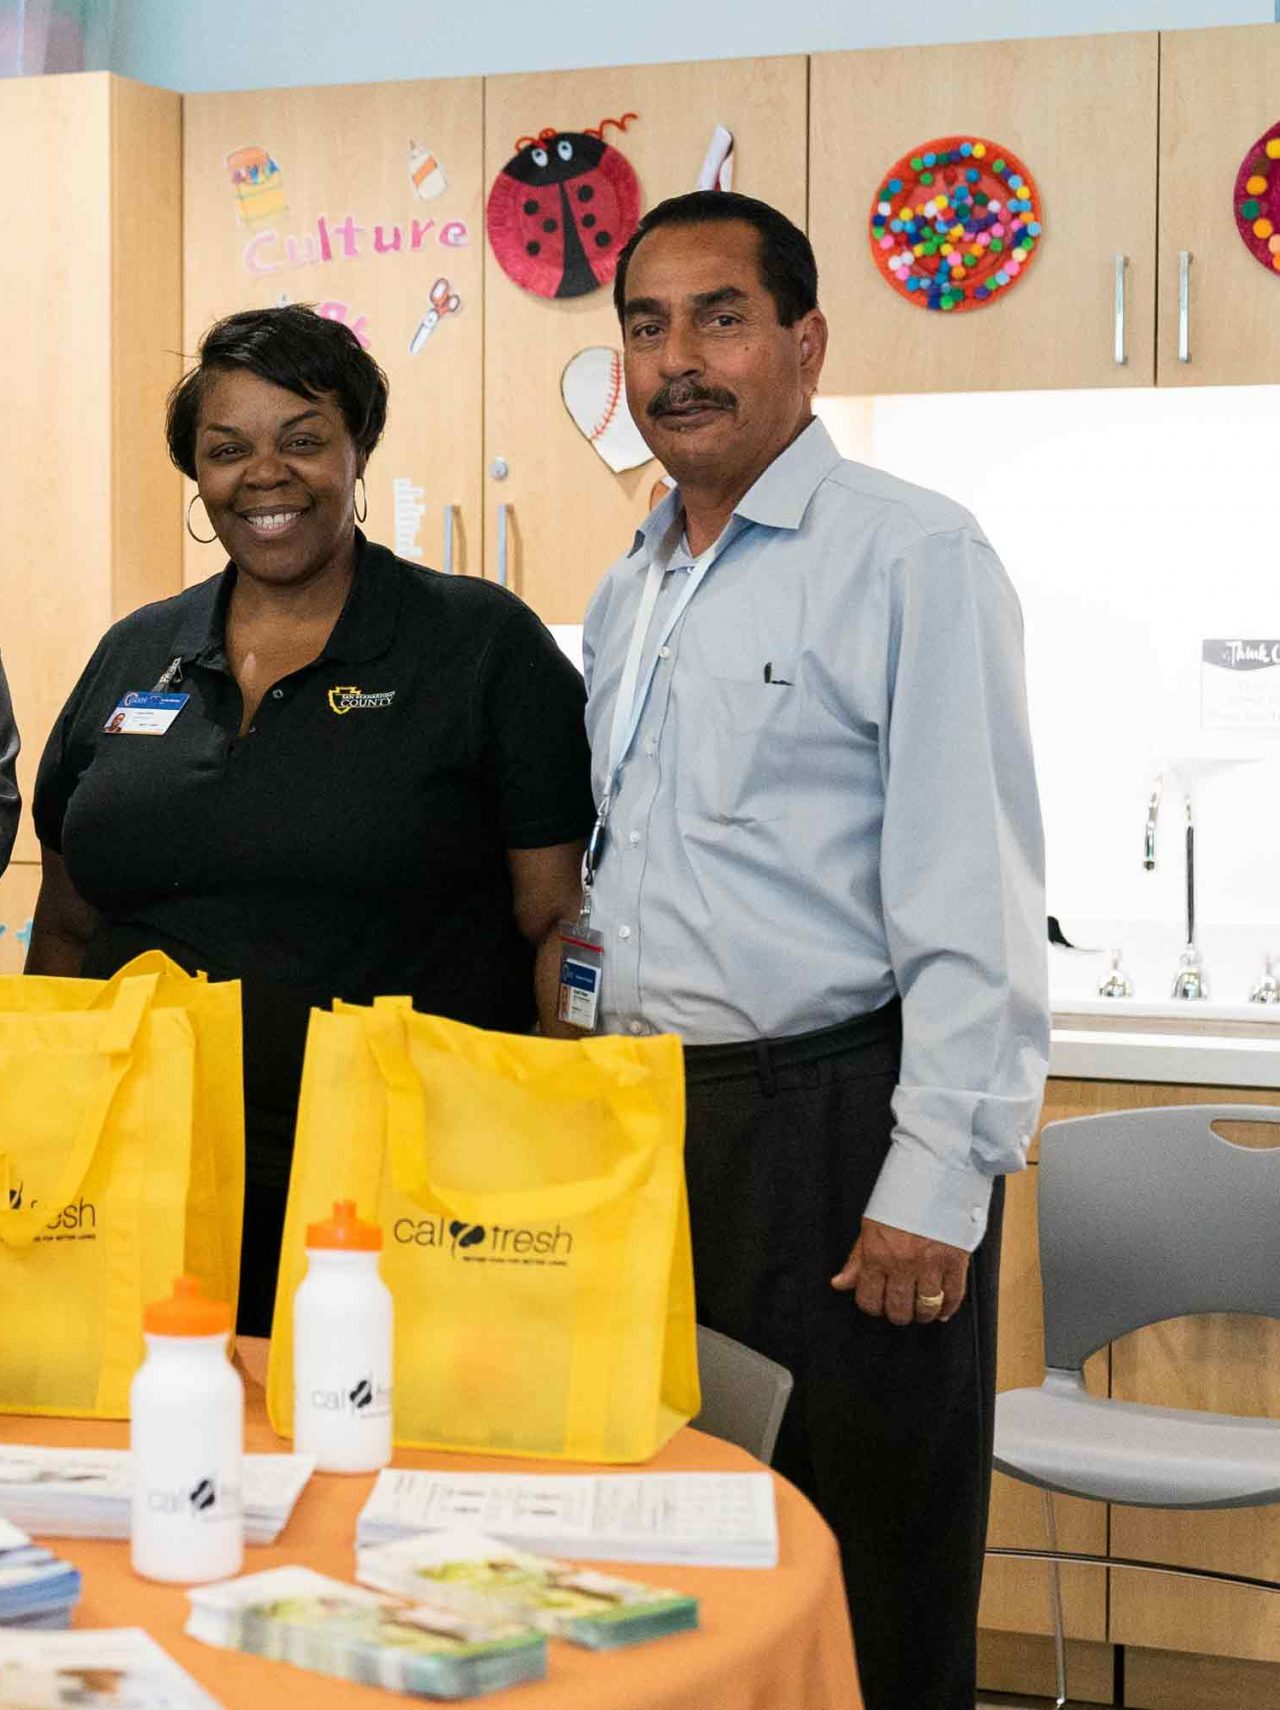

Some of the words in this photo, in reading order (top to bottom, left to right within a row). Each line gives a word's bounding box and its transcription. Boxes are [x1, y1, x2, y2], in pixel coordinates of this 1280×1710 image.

[243, 215, 469, 276] Culture
[340, 697, 393, 708] COUNTY
[393, 1216, 445, 1247] cal
[491, 1223, 573, 1255] fresh
